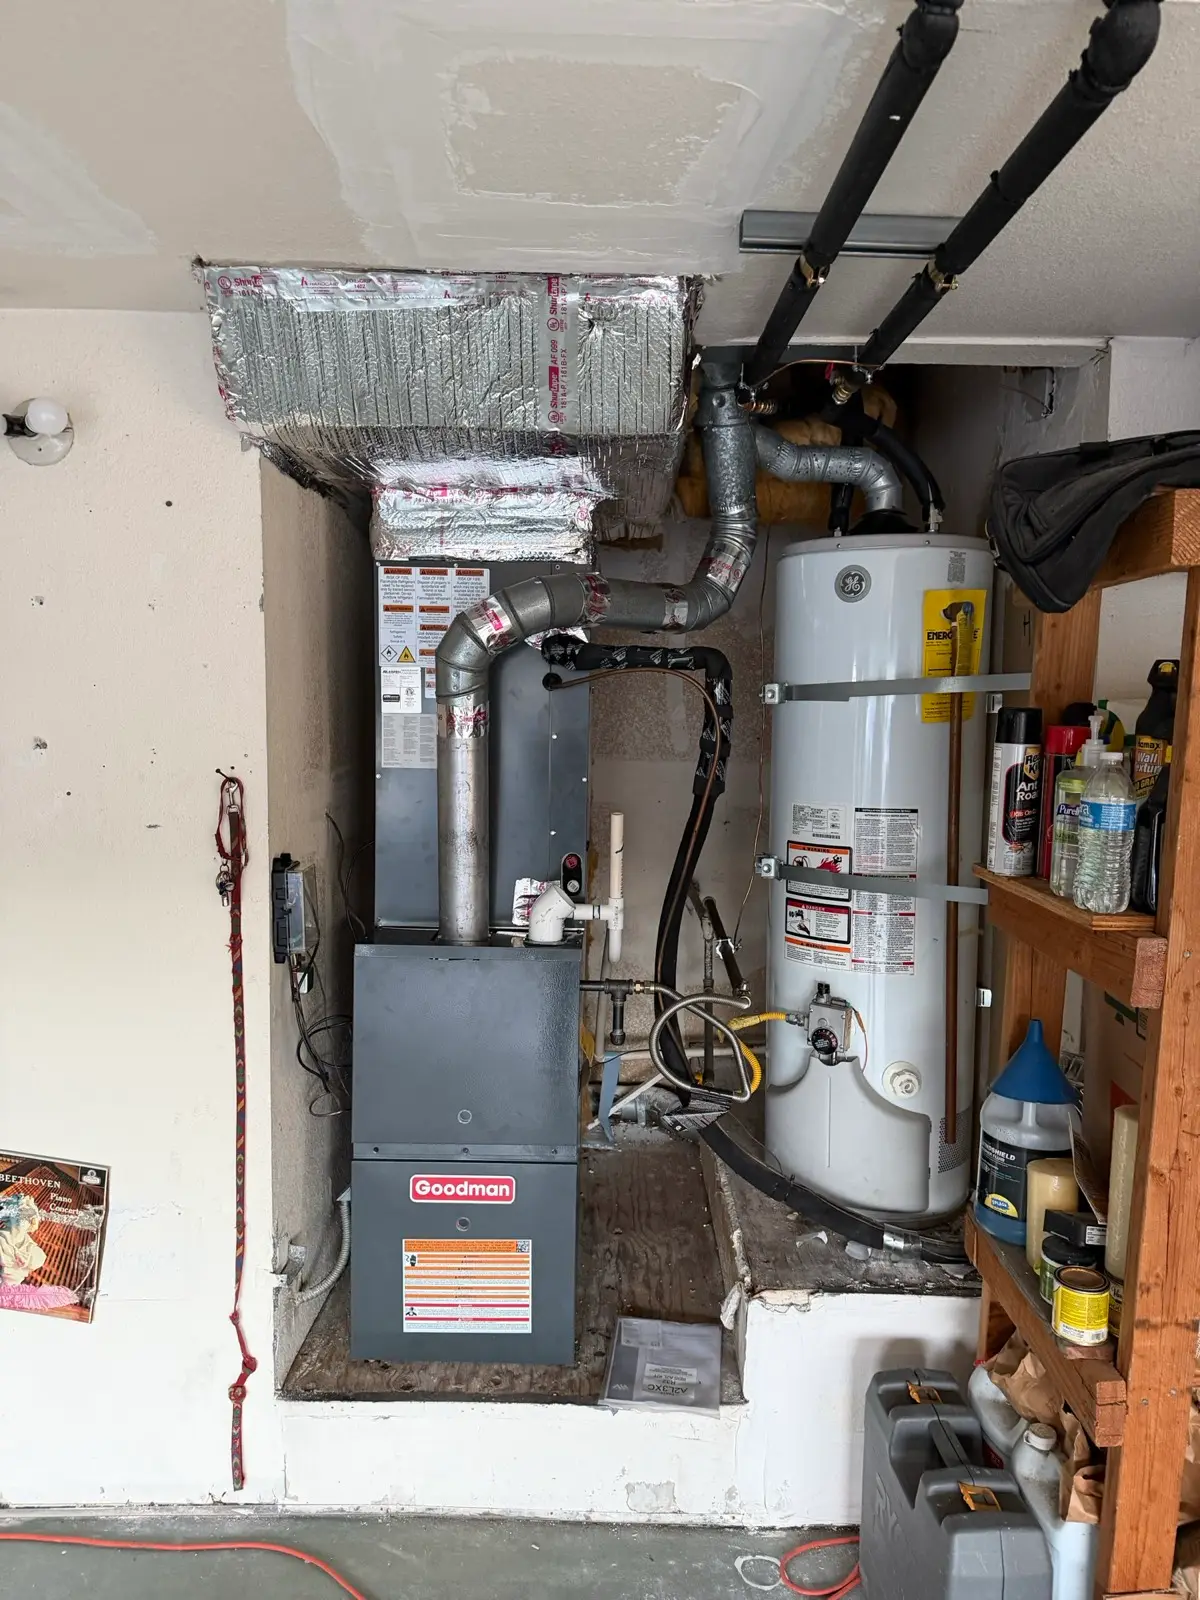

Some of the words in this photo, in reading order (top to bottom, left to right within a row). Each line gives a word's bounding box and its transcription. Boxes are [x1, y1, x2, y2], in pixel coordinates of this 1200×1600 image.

[549, 371, 559, 408] Shurtape
[1016, 782, 1037, 792] Ant
[1016, 792, 1038, 801] Roa
[0, 1174, 61, 1189] BEETHOVEN
[415, 1180, 510, 1197] Goodman
[50, 1193, 72, 1203] Piano
